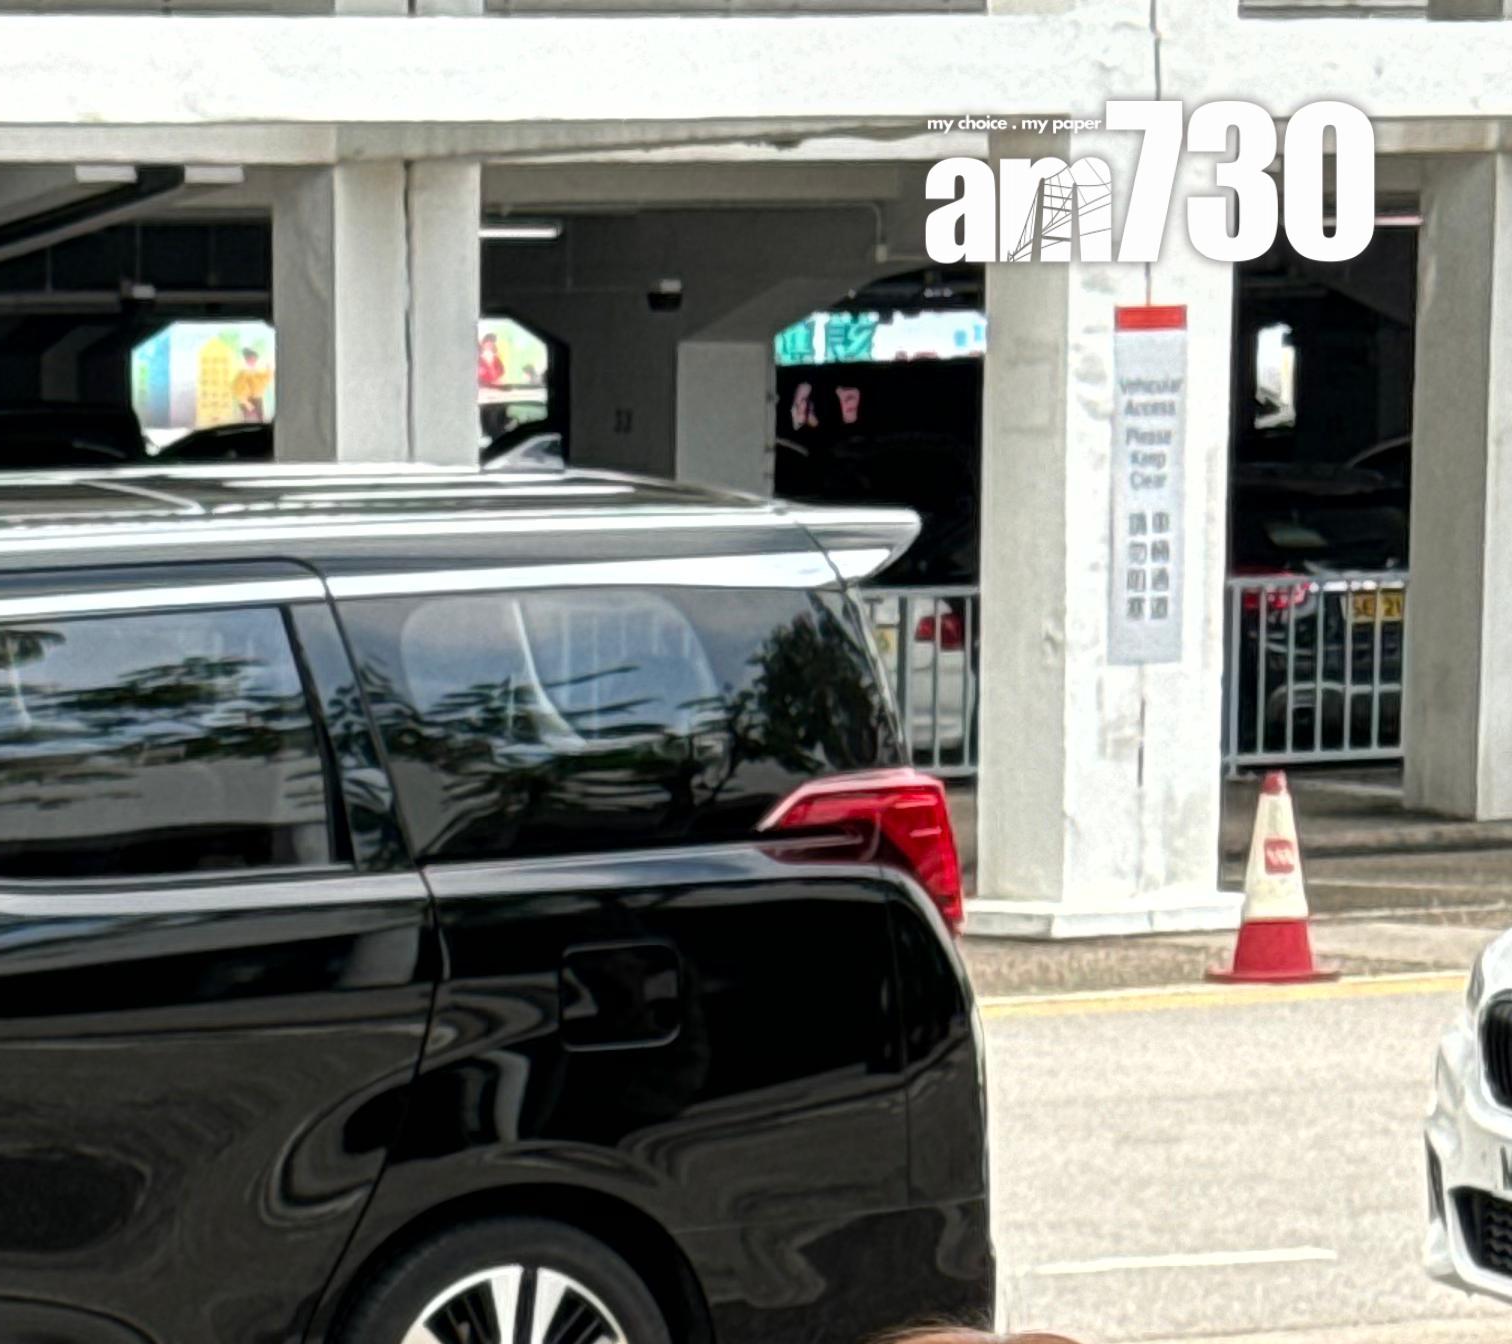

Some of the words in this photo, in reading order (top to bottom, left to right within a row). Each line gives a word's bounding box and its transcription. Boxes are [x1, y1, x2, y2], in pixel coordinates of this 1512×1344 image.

[1124, 399, 1177, 417] Access
[1126, 426, 1173, 446] Please
[1130, 450, 1166, 470] Keep
